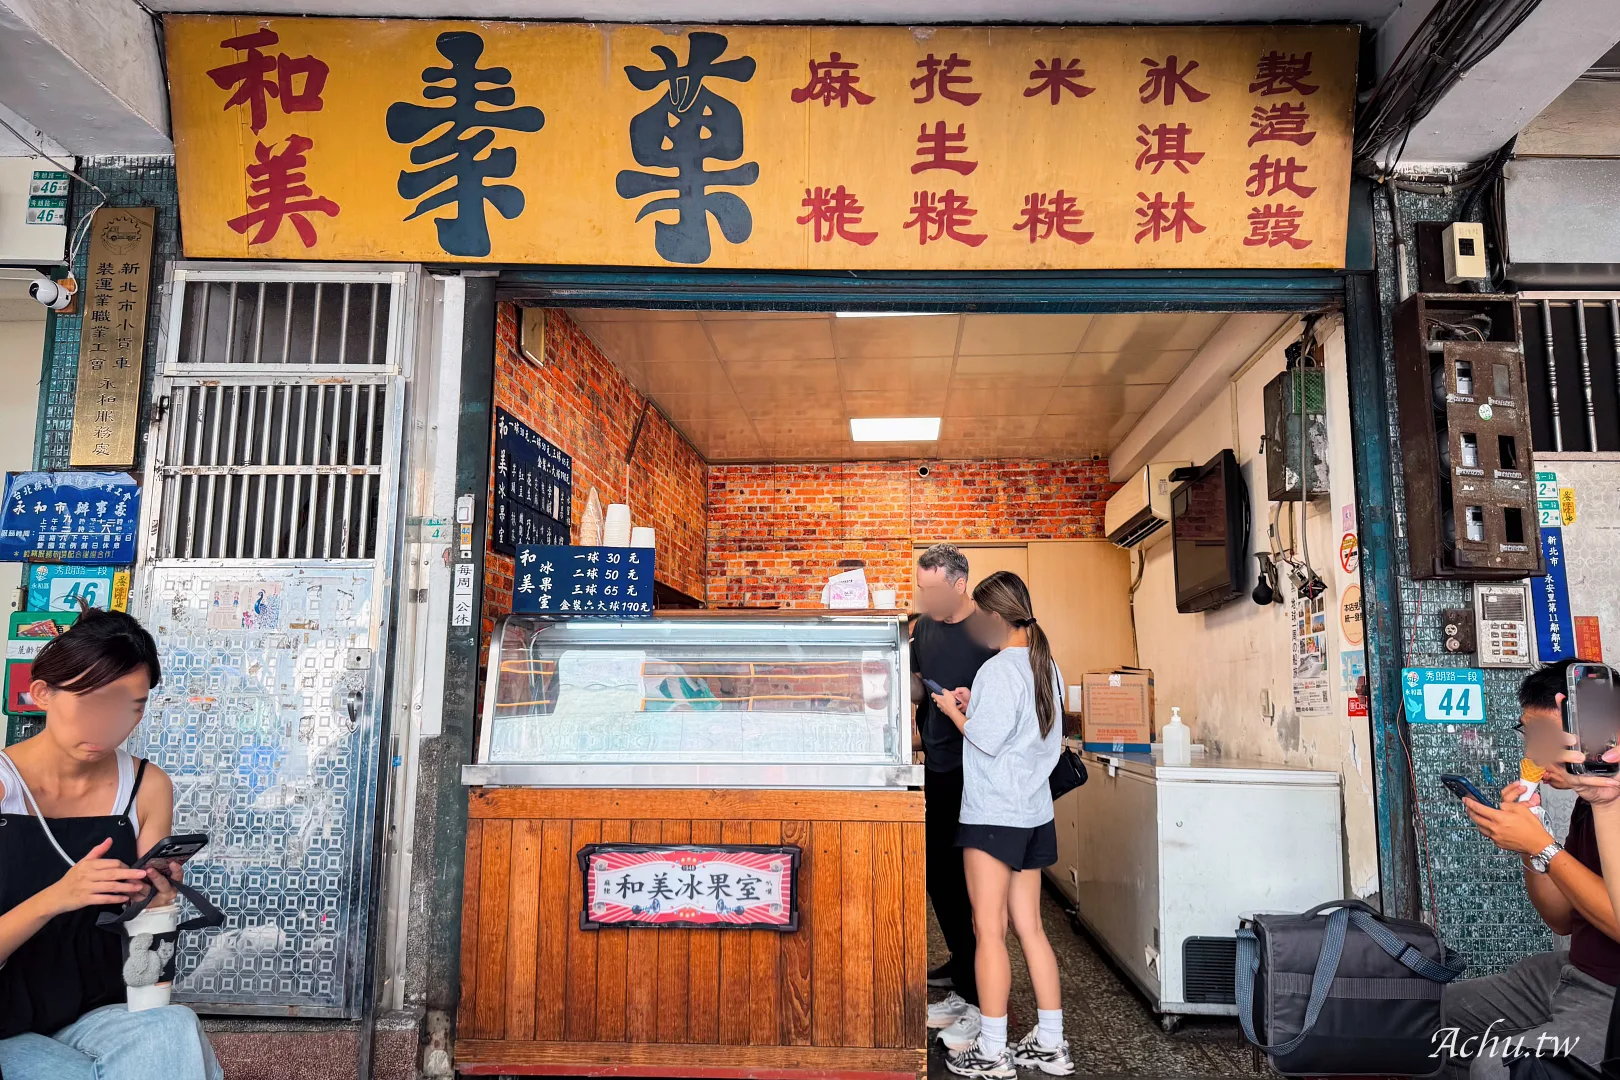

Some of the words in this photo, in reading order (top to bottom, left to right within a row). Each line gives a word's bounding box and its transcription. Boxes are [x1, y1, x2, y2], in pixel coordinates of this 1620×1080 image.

[206, 28, 340, 249] 和美
[1134, 54, 1211, 245] 冰淇淋
[1243, 50, 1321, 251] 製造批發
[41, 181, 58, 194] 46
[37, 209, 54, 222] 46
[89, 262, 116, 371] 裝運業職業工會
[112, 262, 141, 370] 新北市小貨車
[92, 377, 117, 456] 永和服務處
[498, 415, 508, 544] 和美冰果室
[574, 551, 600, 563] 一球
[606, 553, 620, 563] 30
[628, 552, 640, 564] 元
[1547, 535, 1559, 567] 新北市
[54, 565, 108, 576] 秀朗路一段
[517, 549, 536, 593] 和美
[538, 561, 554, 610] 冰果室
[572, 567, 599, 580] 二球
[605, 570, 619, 580] 50
[627, 569, 639, 580] 元
[63, 581, 99, 610] 46
[455, 564, 473, 625] 每周一公休
[571, 584, 598, 596] 三球
[604, 585, 619, 596] 65
[626, 584, 638, 596] 元
[559, 599, 651, 612] 金裝六大球190元
[1425, 670, 1478, 682] 秀朗路一段
[1405, 688, 1423, 696] 永和區
[1438, 688, 1471, 716] 44
[615, 872, 763, 901] 和美冰果室
